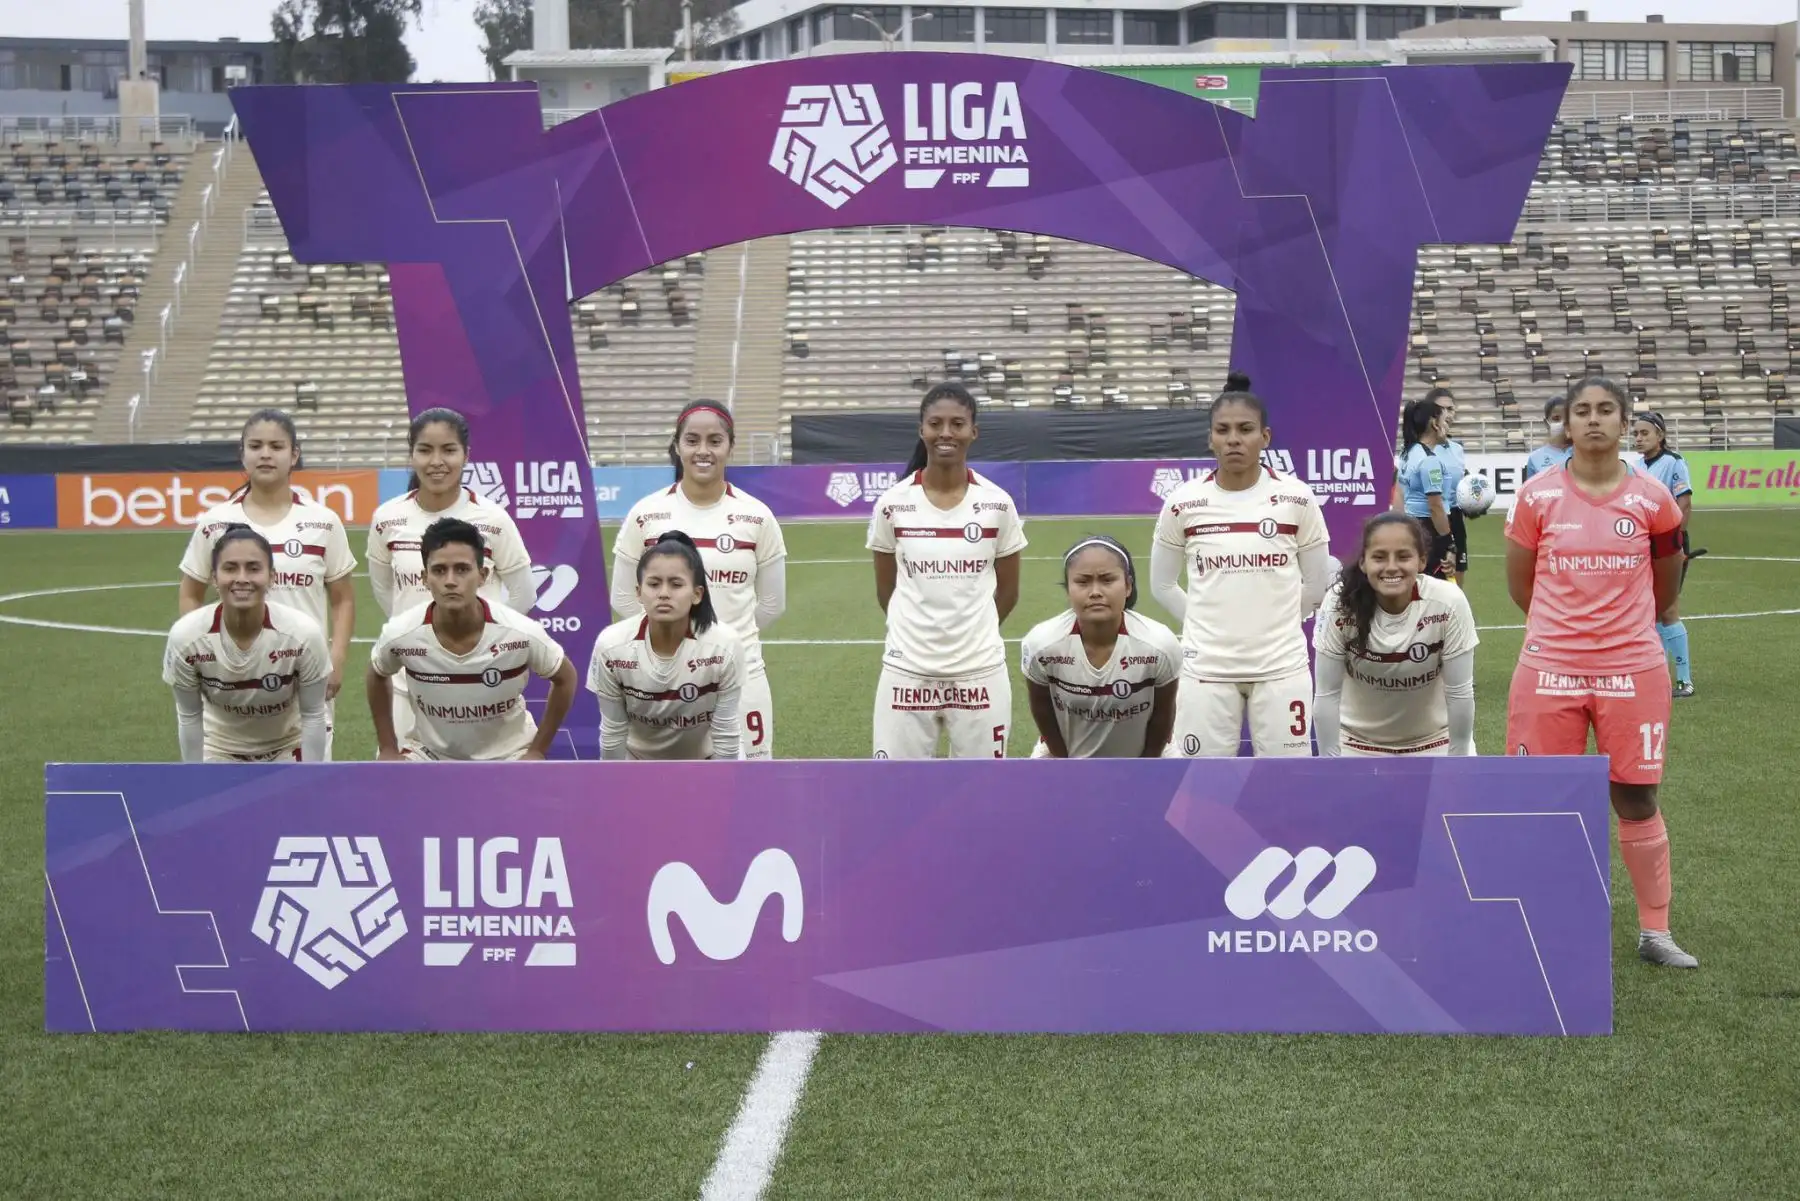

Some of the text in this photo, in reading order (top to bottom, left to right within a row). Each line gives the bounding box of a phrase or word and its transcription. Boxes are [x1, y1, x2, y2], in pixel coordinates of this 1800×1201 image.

[904, 81, 1027, 141] LIGA
[904, 146, 1029, 164] FEMENINA
[952, 172, 980, 184] FPF
[1308, 448, 1375, 481] LIGA
[515, 461, 583, 493] LIGA
[1310, 483, 1375, 493] FEMENINA
[83, 476, 354, 527] betsn
[516, 496, 583, 506] FEMENINA
[1279, 494, 1309, 507] SPORADE
[901, 530, 937, 538] marathon
[967, 527, 979, 540] U
[1196, 525, 1230, 533] marathon
[1262, 520, 1275, 535] U
[288, 543, 300, 556] U
[393, 542, 421, 551] maratho
[720, 536, 732, 549] U
[1205, 553, 1289, 570] INMUNIMED
[705, 570, 748, 585] NIMED
[398, 648, 427, 657] SPORADE
[499, 640, 530, 651] SPORADE
[1412, 645, 1425, 661] U
[1129, 655, 1159, 666] SPORADE
[266, 677, 278, 690] U
[415, 673, 450, 682] marathon
[486, 671, 498, 684] U
[682, 686, 695, 700] U
[892, 687, 990, 703] TIENDA CREMA
[1058, 682, 1092, 694] marathon
[1116, 684, 1128, 696] U
[427, 698, 516, 719] INMUNIMED
[1289, 700, 1306, 737] 3
[746, 710, 764, 747] 9
[993, 724, 1005, 759] 5
[1639, 722, 1664, 761] 12
[423, 836, 574, 908] LIGA
[423, 915, 577, 937] FEMENINA
[1207, 929, 1379, 953] MEDIAPRO
[482, 947, 517, 963] FPF
